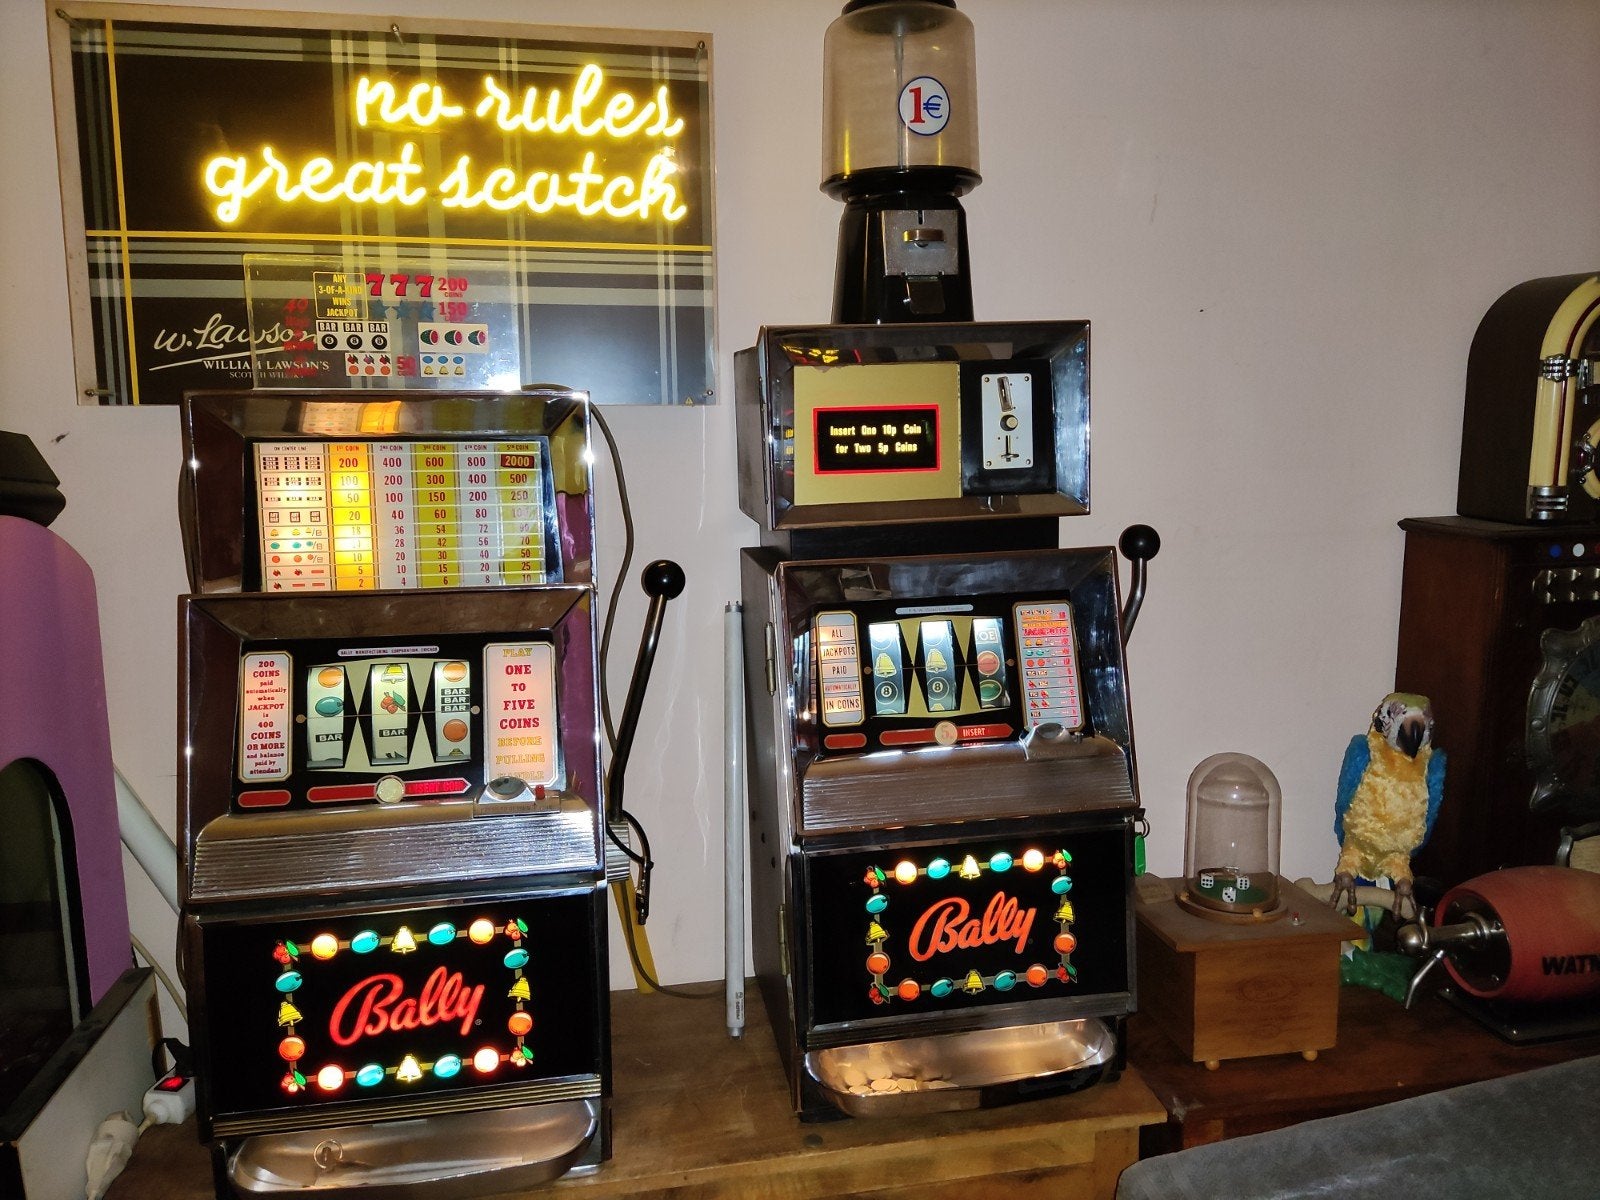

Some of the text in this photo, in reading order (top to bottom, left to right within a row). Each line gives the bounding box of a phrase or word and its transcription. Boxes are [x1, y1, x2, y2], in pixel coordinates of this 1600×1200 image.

[354, 62, 684, 138] no rules
[205, 141, 688, 223] great scotch
[333, 274, 347, 283] ANY
[438, 277, 468, 291] 200
[318, 286, 362, 294] 3-OF-A-KIND
[333, 297, 351, 306] WINS
[327, 308, 358, 317] JACKPOT
[439, 302, 467, 315] 150
[320, 322, 336, 331] BAR
[345, 323, 362, 332] BAR
[370, 324, 386, 332] BAR
[266, 360, 330, 370] LAWSON'S
[830, 424, 921, 436] Insert One 10p Coin
[835, 442, 917, 455] for Two 5p Coins
[339, 456, 529, 468] 200 400 600 800 2000
[340, 474, 527, 486] 100 200 300 400 500
[347, 491, 528, 503] 50 100 150 200 250
[349, 511, 361, 521] 20
[391, 510, 404, 520] 40
[434, 509, 446, 519] 60
[475, 508, 487, 518] 80
[395, 526, 404, 535] 36
[436, 524, 446, 533] 54
[479, 524, 488, 533] 72
[395, 539, 404, 547] 28
[437, 538, 446, 547] 42
[478, 537, 489, 546] 56
[521, 537, 530, 545] 70
[353, 549, 530, 561] 10 20 30 40 50
[358, 562, 531, 575] 5 10 15 20 25
[359, 574, 531, 588] 2 4 6 8 10
[831, 629, 843, 638] ALL
[503, 648, 532, 657] PLAY
[823, 646, 855, 657] JACKPOTS
[253, 670, 280, 678] COINS
[505, 665, 531, 676] ONE
[832, 666, 847, 675] PAID
[511, 683, 526, 691] TO
[248, 703, 284, 711] JACKPOT
[503, 699, 535, 711] FIVE
[826, 699, 860, 709] IN COINS
[500, 718, 540, 729] COINS
[251, 731, 281, 740] COINS
[319, 733, 343, 742] BAR
[382, 729, 405, 737] BAR
[962, 728, 985, 736] INSERT
[497, 736, 542, 747] BEFORE
[496, 753, 545, 764] PULLING
[497, 771, 544, 780] NDLE
[908, 890, 1037, 962] Bally
[328, 965, 486, 1047] Bally
